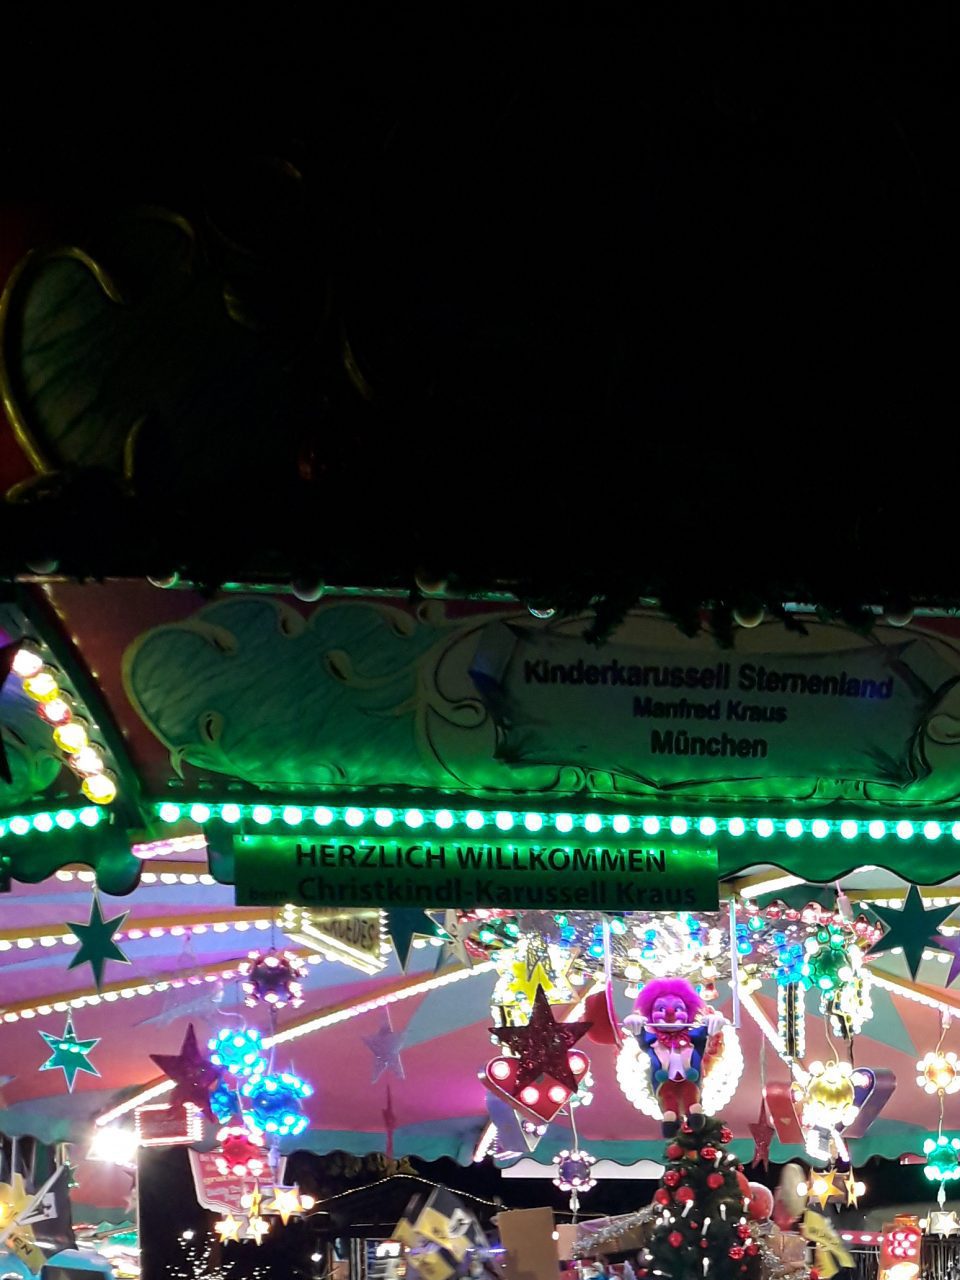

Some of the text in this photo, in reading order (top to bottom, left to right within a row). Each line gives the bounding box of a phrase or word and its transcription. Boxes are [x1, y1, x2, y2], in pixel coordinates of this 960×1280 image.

[523, 660, 894, 699] Kinderkarussell Sternenland
[633, 696, 788, 723] Manfred Kraus
[650, 729, 768, 758] München
[296, 843, 667, 873] HERZLICH WILLKOMMEN
[297, 876, 607, 905] Christkindl-Karussell
[615, 880, 697, 905] Kraus
